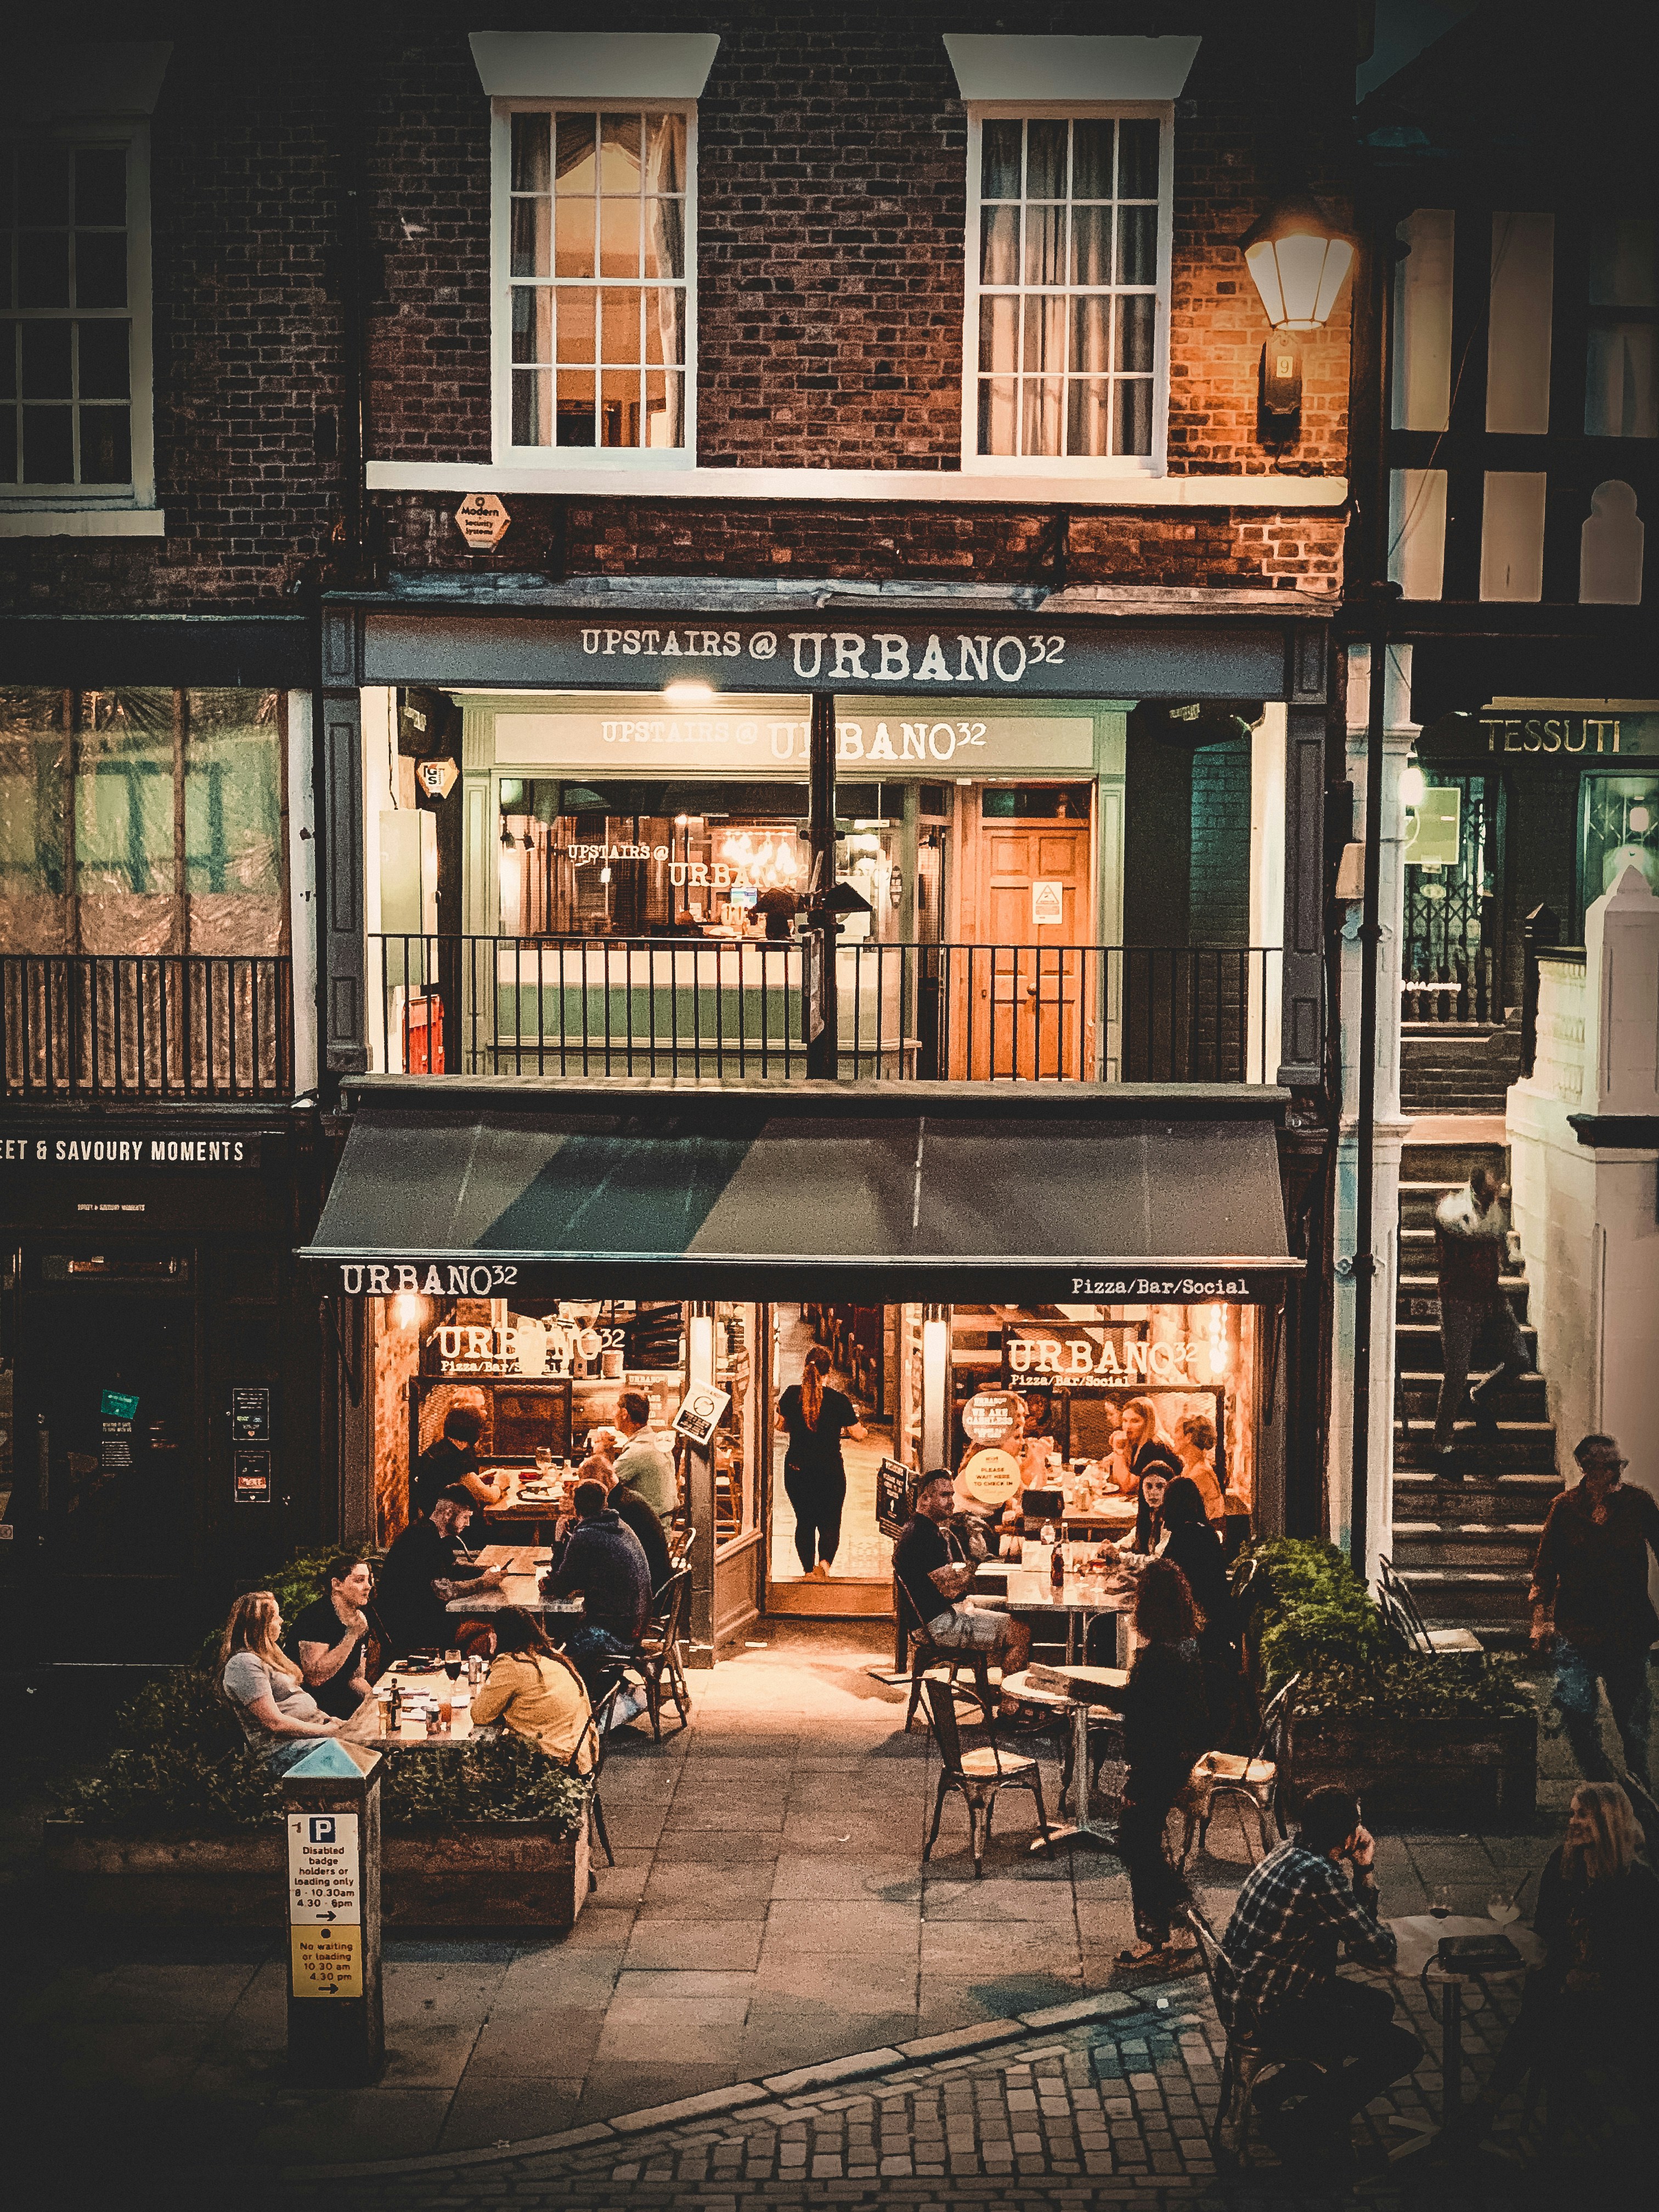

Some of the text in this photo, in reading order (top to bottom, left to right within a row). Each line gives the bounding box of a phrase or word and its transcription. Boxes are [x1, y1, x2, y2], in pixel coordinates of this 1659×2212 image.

[1280, 359, 1289, 374] 9
[580, 629, 741, 656] UPSTAIRS
[749, 631, 777, 659] @
[601, 720, 729, 742] UPSTAIRS
[1479, 719, 1620, 753] TESSUTI
[567, 844, 650, 860] UPSTAIRS
[37, 1141, 47, 1160] &
[56, 1141, 143, 1161] SAVOURY
[151, 1141, 244, 1161] MOMENTS
[1071, 1278, 1249, 1295] Pizza/Bar/Social
[316, 1820, 331, 1841] P
[302, 1847, 345, 1855] Disabled
[309, 1857, 338, 1866] badge
[299, 1867, 336, 1875] holders
[294, 1877, 354, 1887] loading only
[295, 1888, 301, 1897] 8
[331, 1899, 353, 1908] 6pm
[300, 1942, 353, 1951] No waiting
[315, 1953, 352, 1962] loading
